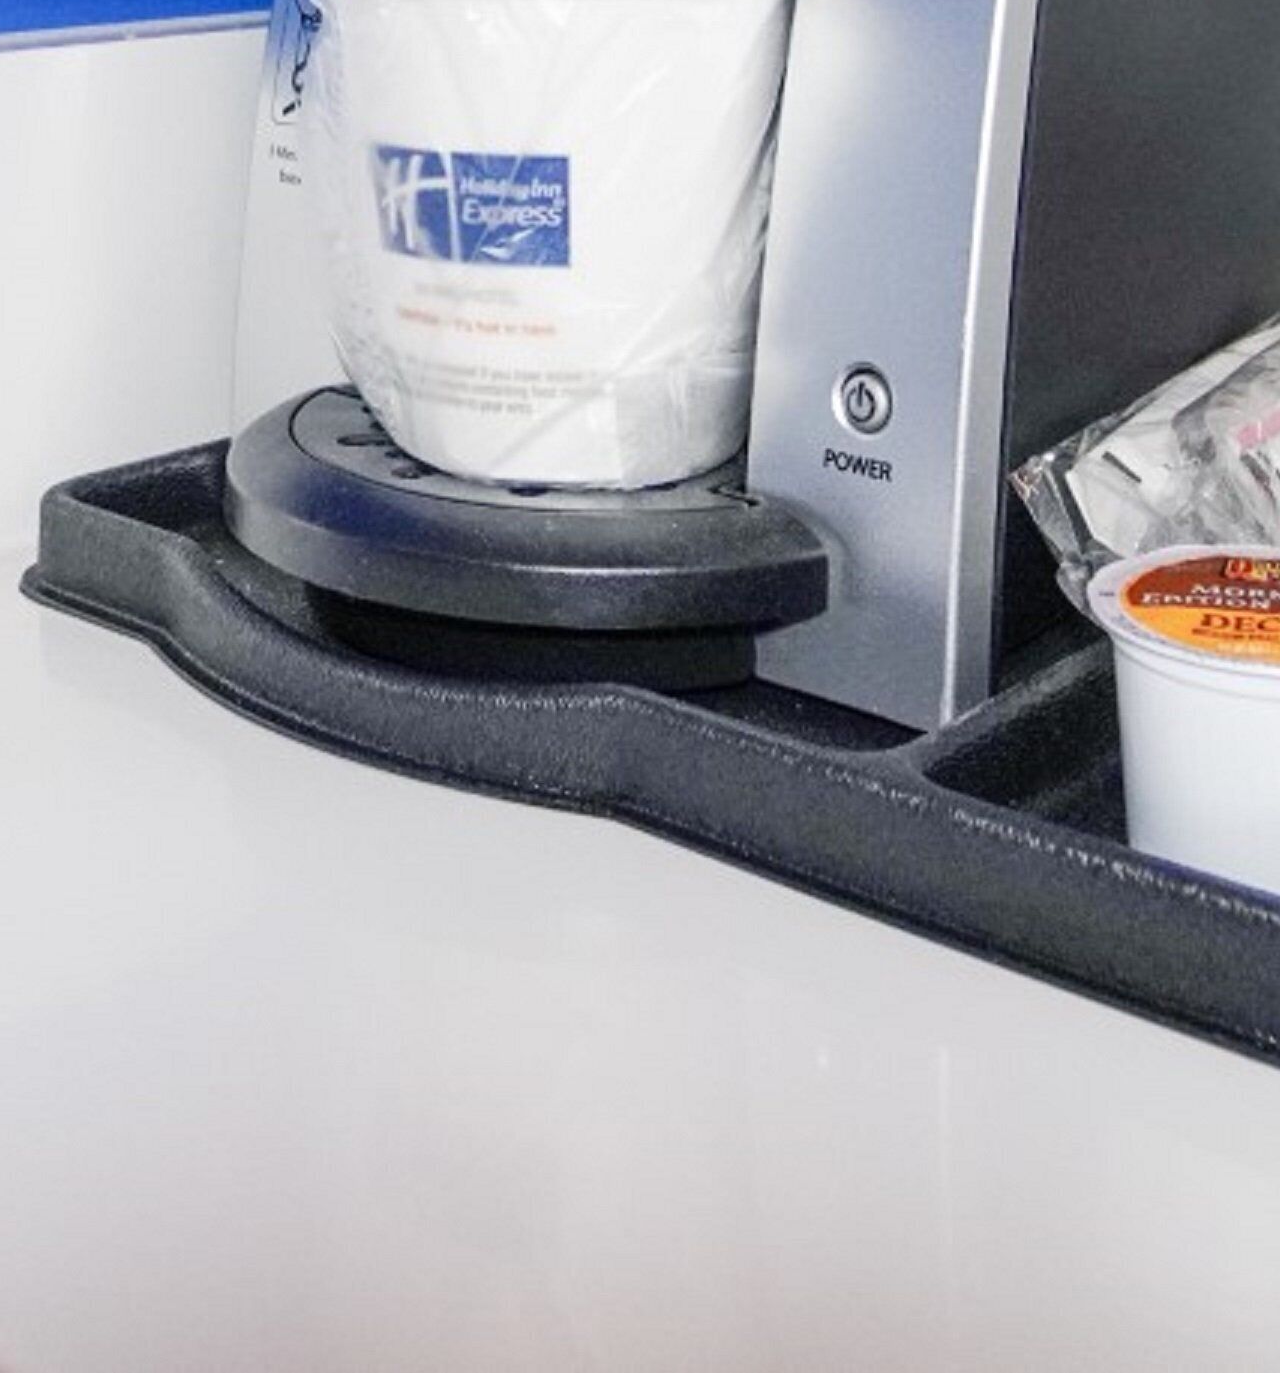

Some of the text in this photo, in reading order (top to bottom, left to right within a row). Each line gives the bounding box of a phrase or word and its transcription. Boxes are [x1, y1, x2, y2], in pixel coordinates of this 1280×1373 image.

[460, 196, 563, 230] Express
[823, 447, 893, 483] POWER
[1141, 592, 1270, 611] EDITION
